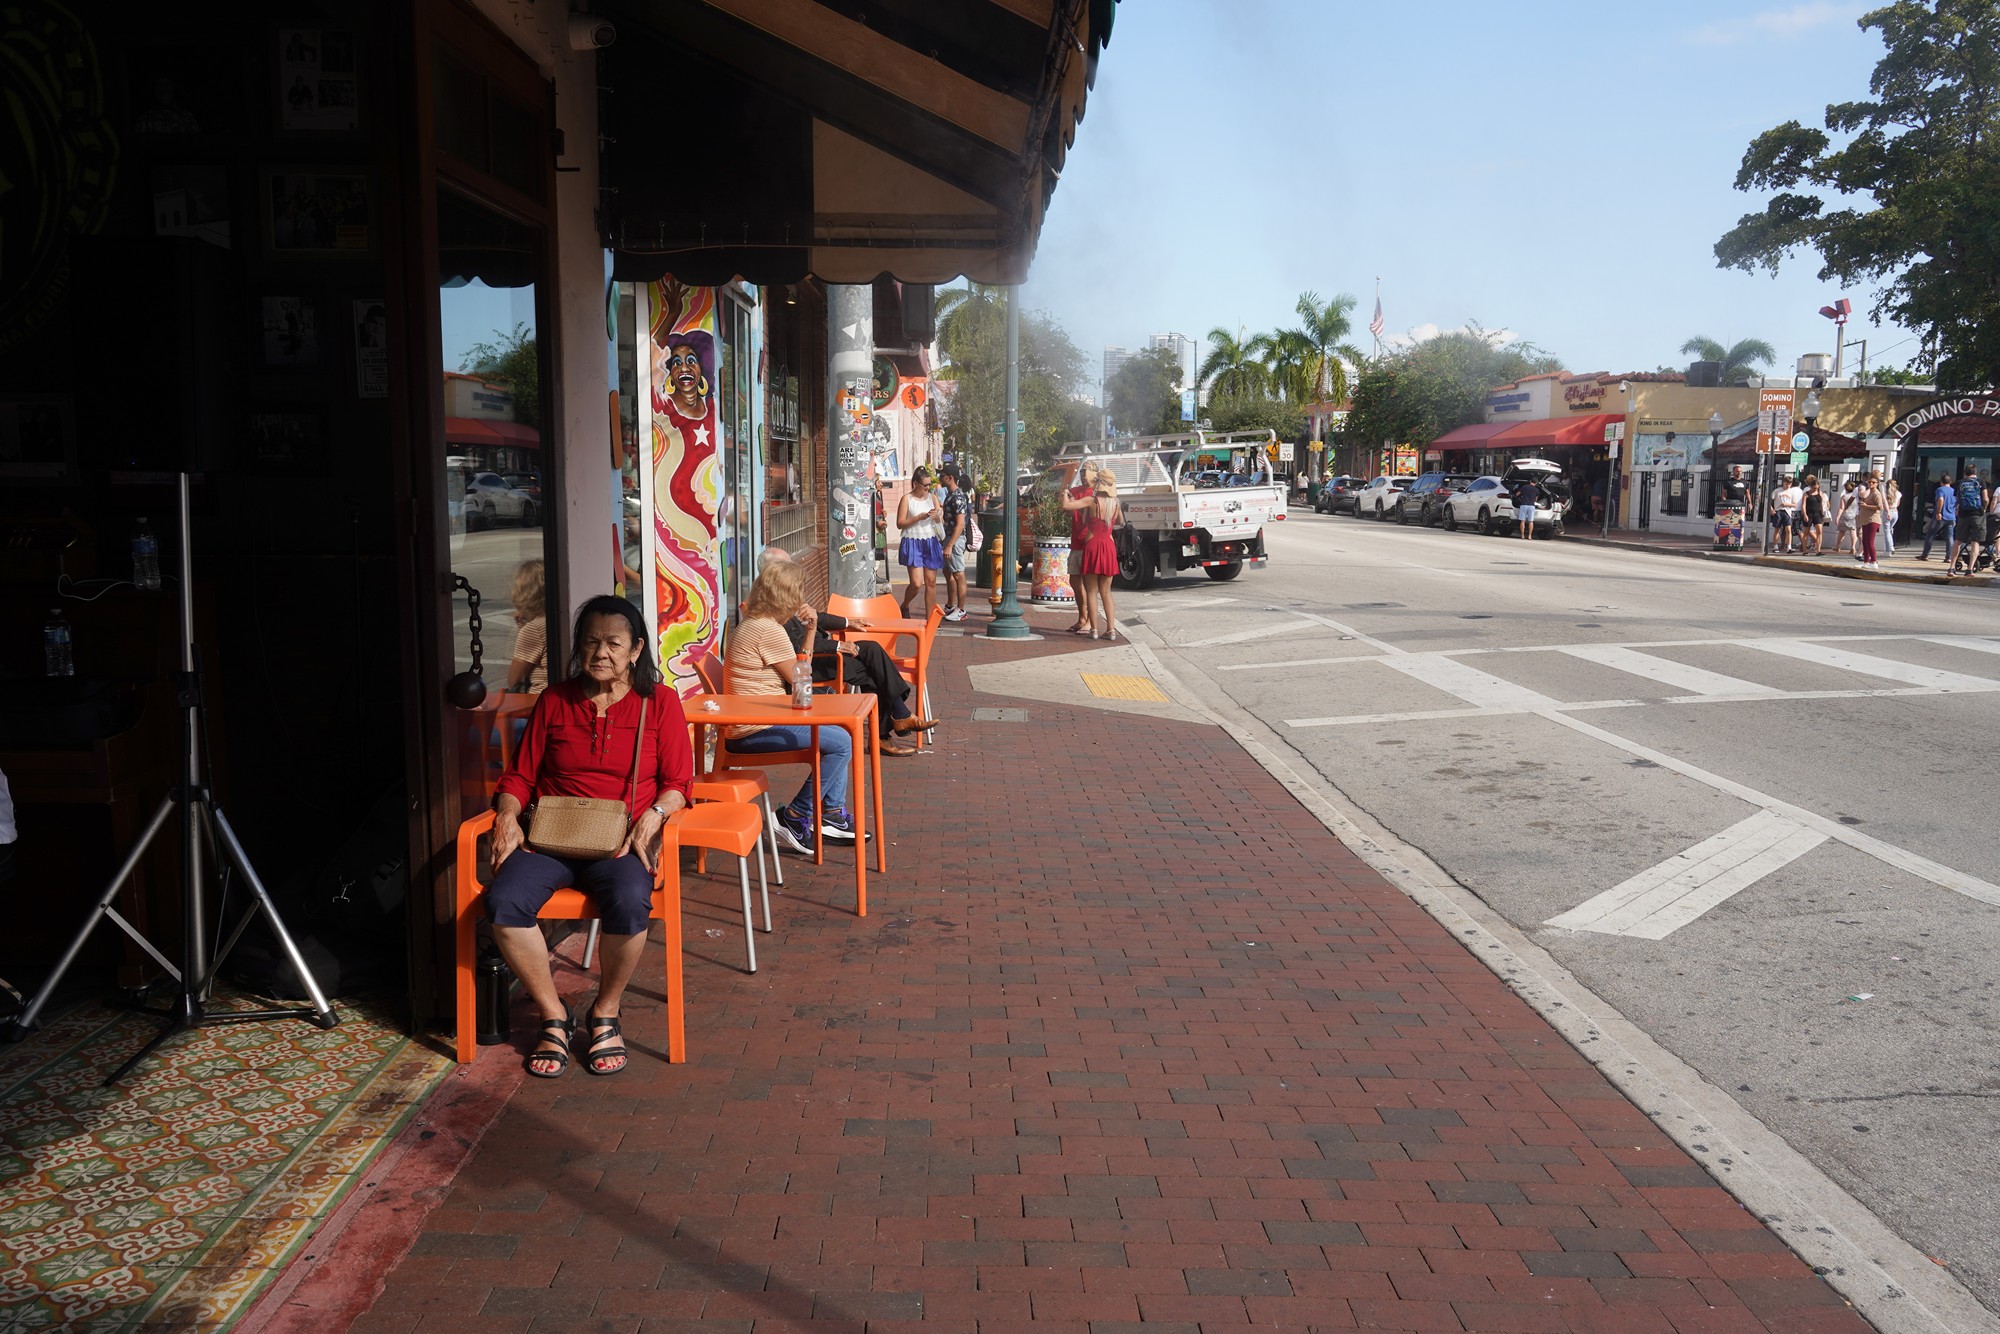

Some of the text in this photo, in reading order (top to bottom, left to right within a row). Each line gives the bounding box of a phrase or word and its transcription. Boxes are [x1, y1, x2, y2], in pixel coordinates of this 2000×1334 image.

[1762, 393, 1792, 402] DOMINO
[1892, 398, 1974, 438] DOMINO
[1282, 452, 1292, 460] 30
[803, 683, 811, 695] G
